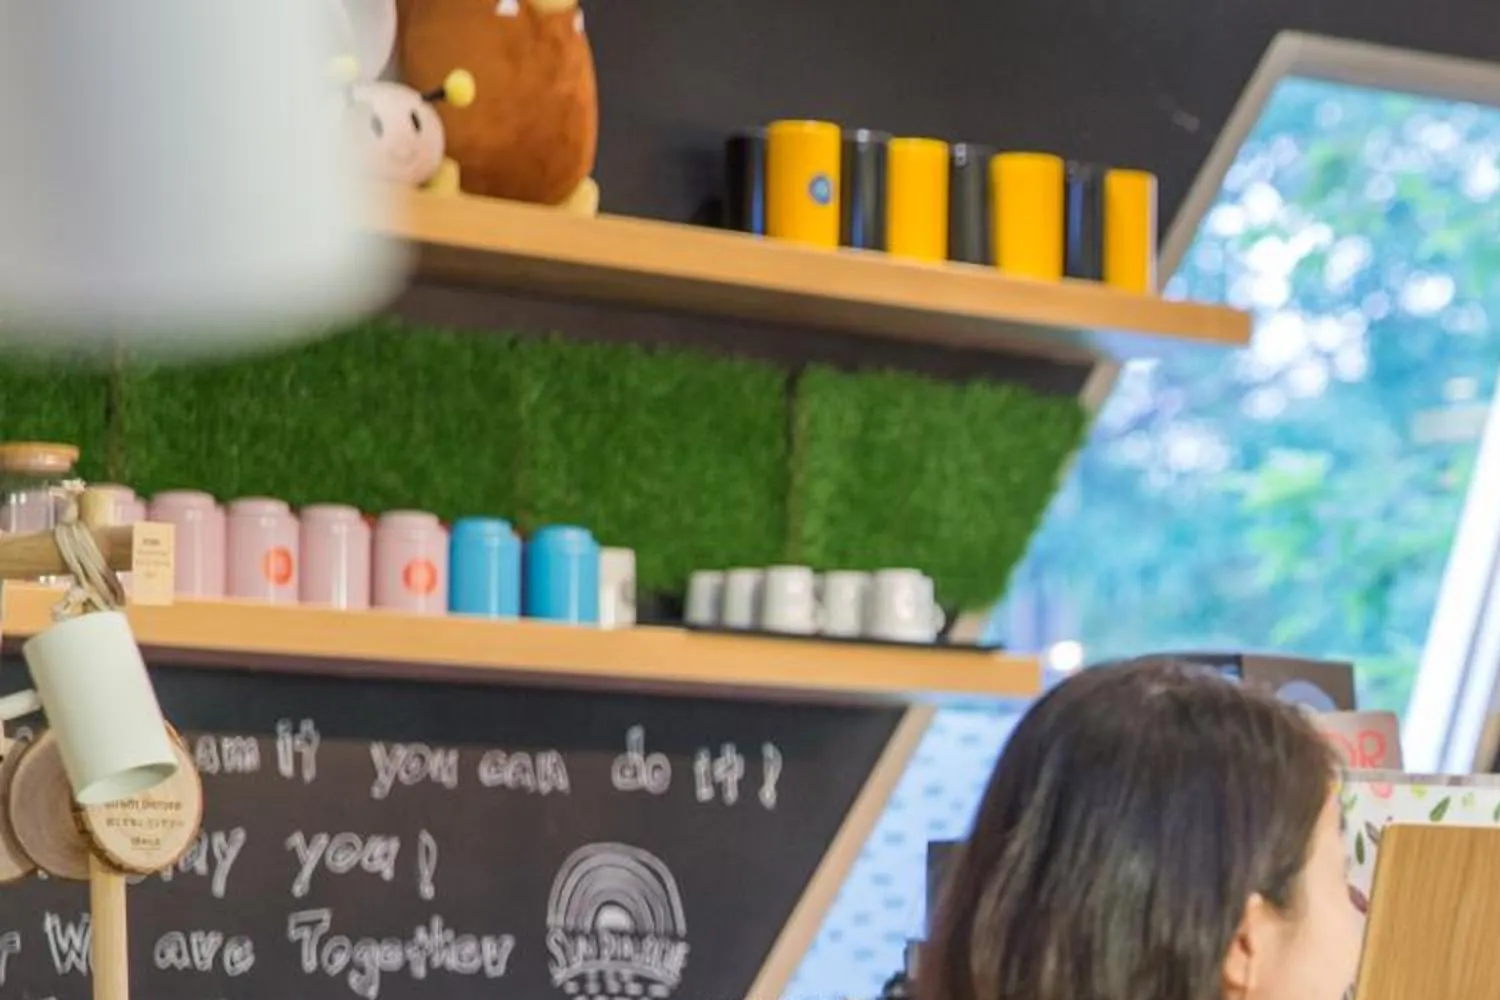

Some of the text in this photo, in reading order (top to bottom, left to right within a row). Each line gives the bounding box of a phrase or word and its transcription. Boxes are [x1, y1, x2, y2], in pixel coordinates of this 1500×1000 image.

[369, 741, 459, 800] you
[611, 724, 672, 795] do
[44, 911, 94, 976] W
[154, 931, 256, 977] are
